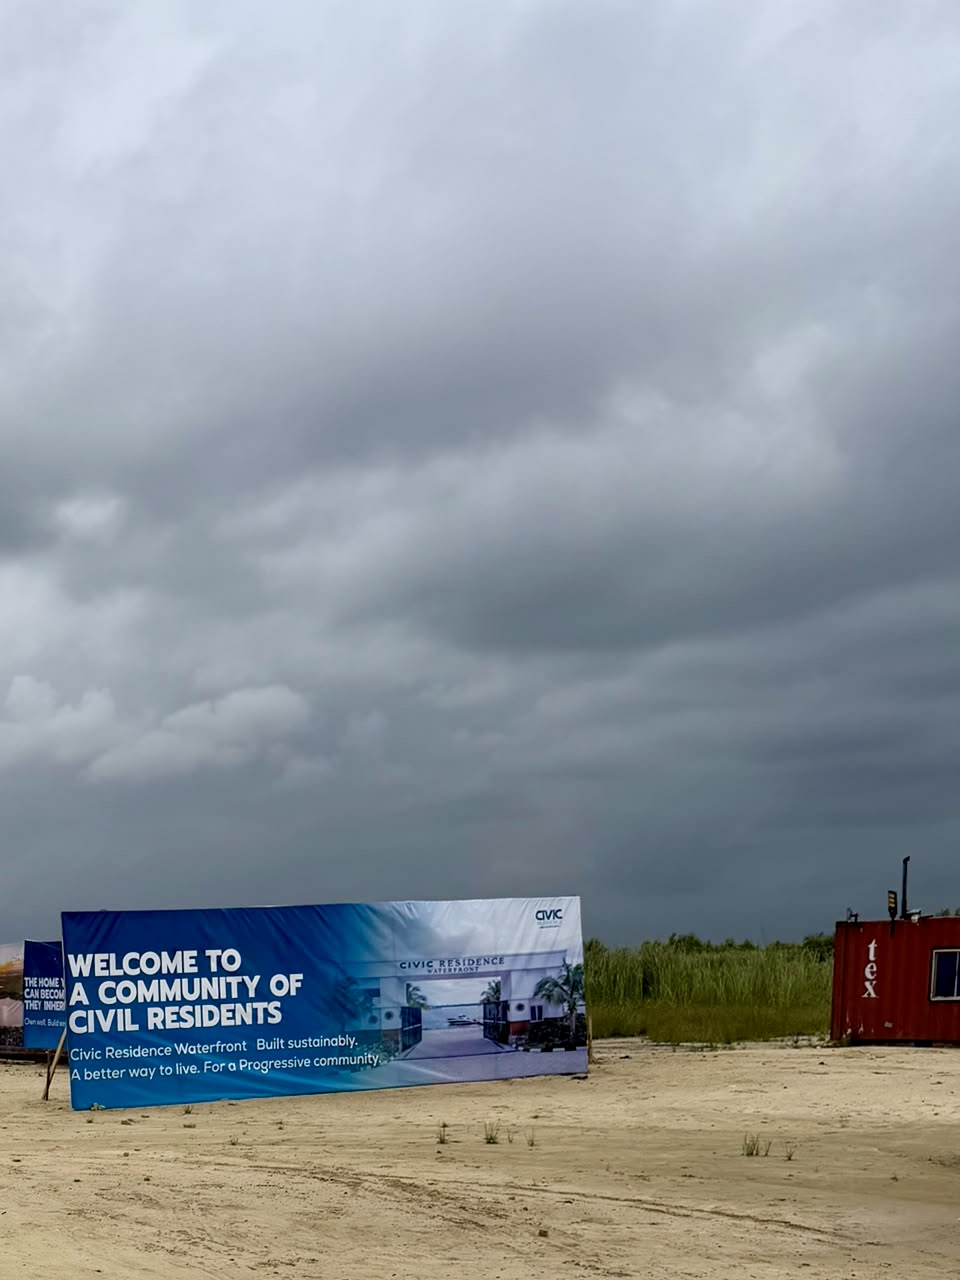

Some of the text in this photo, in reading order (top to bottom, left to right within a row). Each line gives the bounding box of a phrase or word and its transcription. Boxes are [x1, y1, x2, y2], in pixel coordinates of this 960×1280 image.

[535, 909, 563, 921] CIVIC
[68, 948, 241, 977] WELCOME TO
[399, 957, 505, 970] CIVIC RESIDENCE
[426, 966, 480, 974] WATERFRONT
[861, 938, 879, 998] tex
[24, 977, 38, 988] THE
[38, 977, 60, 988] HOME
[69, 973, 303, 1006] A COMMUNITY OF
[24, 988, 40, 999] CAN
[24, 1000, 41, 1011] THEY
[68, 1001, 283, 1034] CIVIL RESIDENTS
[70, 1034, 358, 1061] Civic Residence Waterfront Built sustainably.
[71, 1053, 381, 1081] A better way to live. For a Progressive community.
